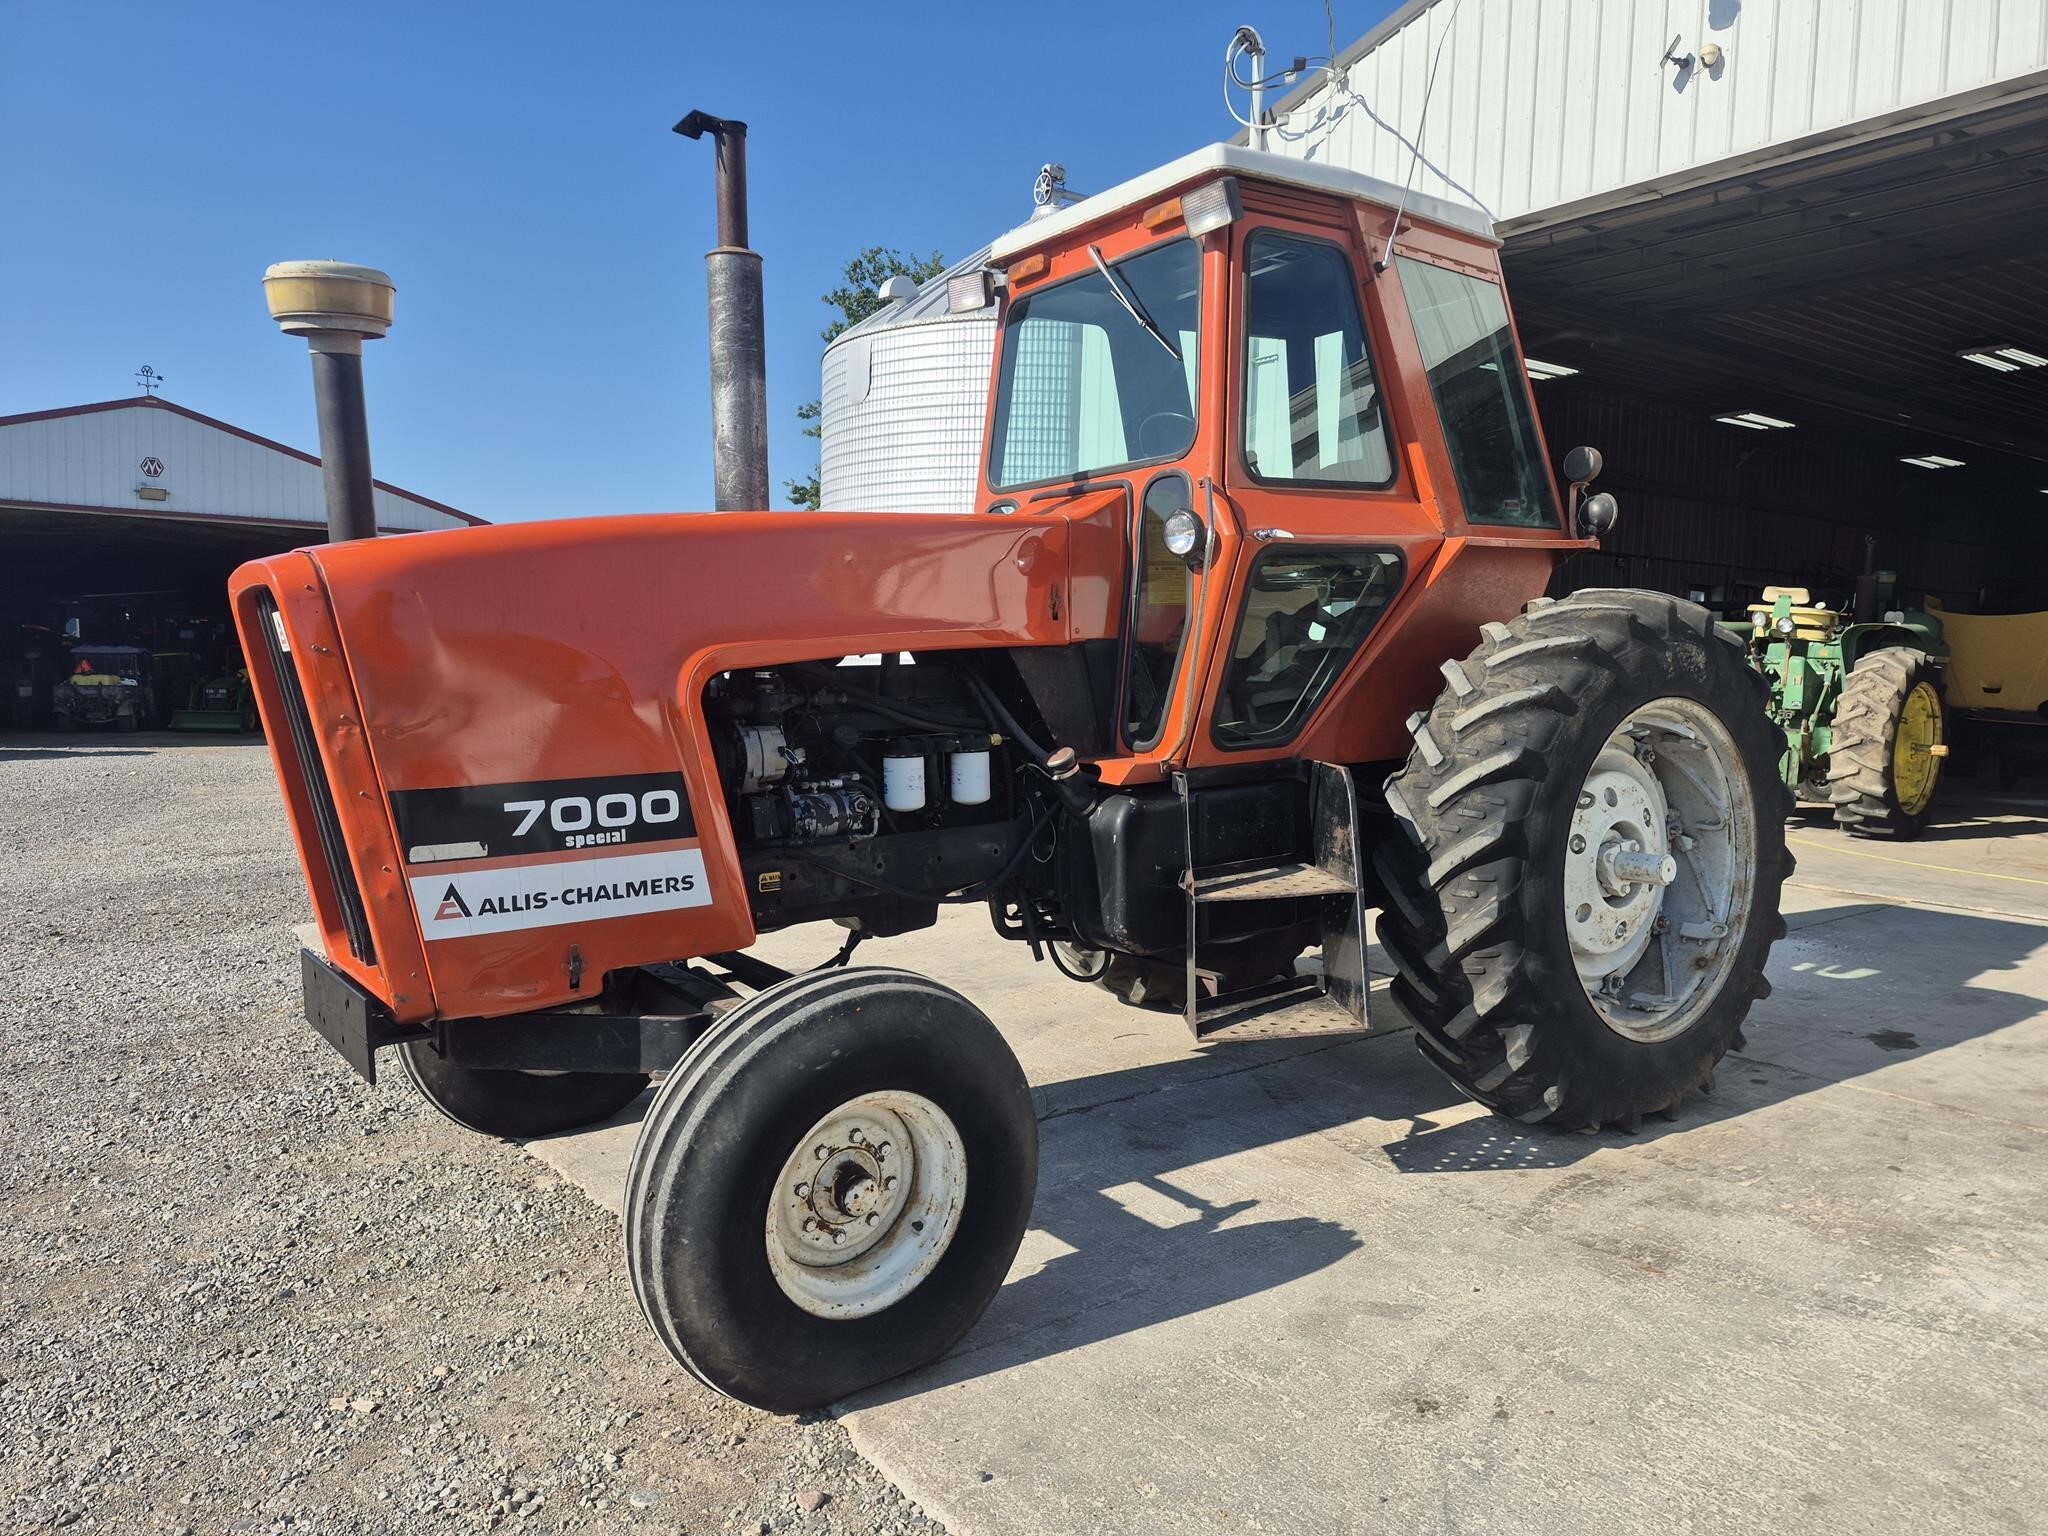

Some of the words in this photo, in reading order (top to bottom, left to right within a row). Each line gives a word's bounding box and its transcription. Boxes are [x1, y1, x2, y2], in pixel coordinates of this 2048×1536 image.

[503, 789, 680, 837] 7000
[565, 828, 627, 848] special
[478, 875, 694, 916] ALLIS-CHALMERS
